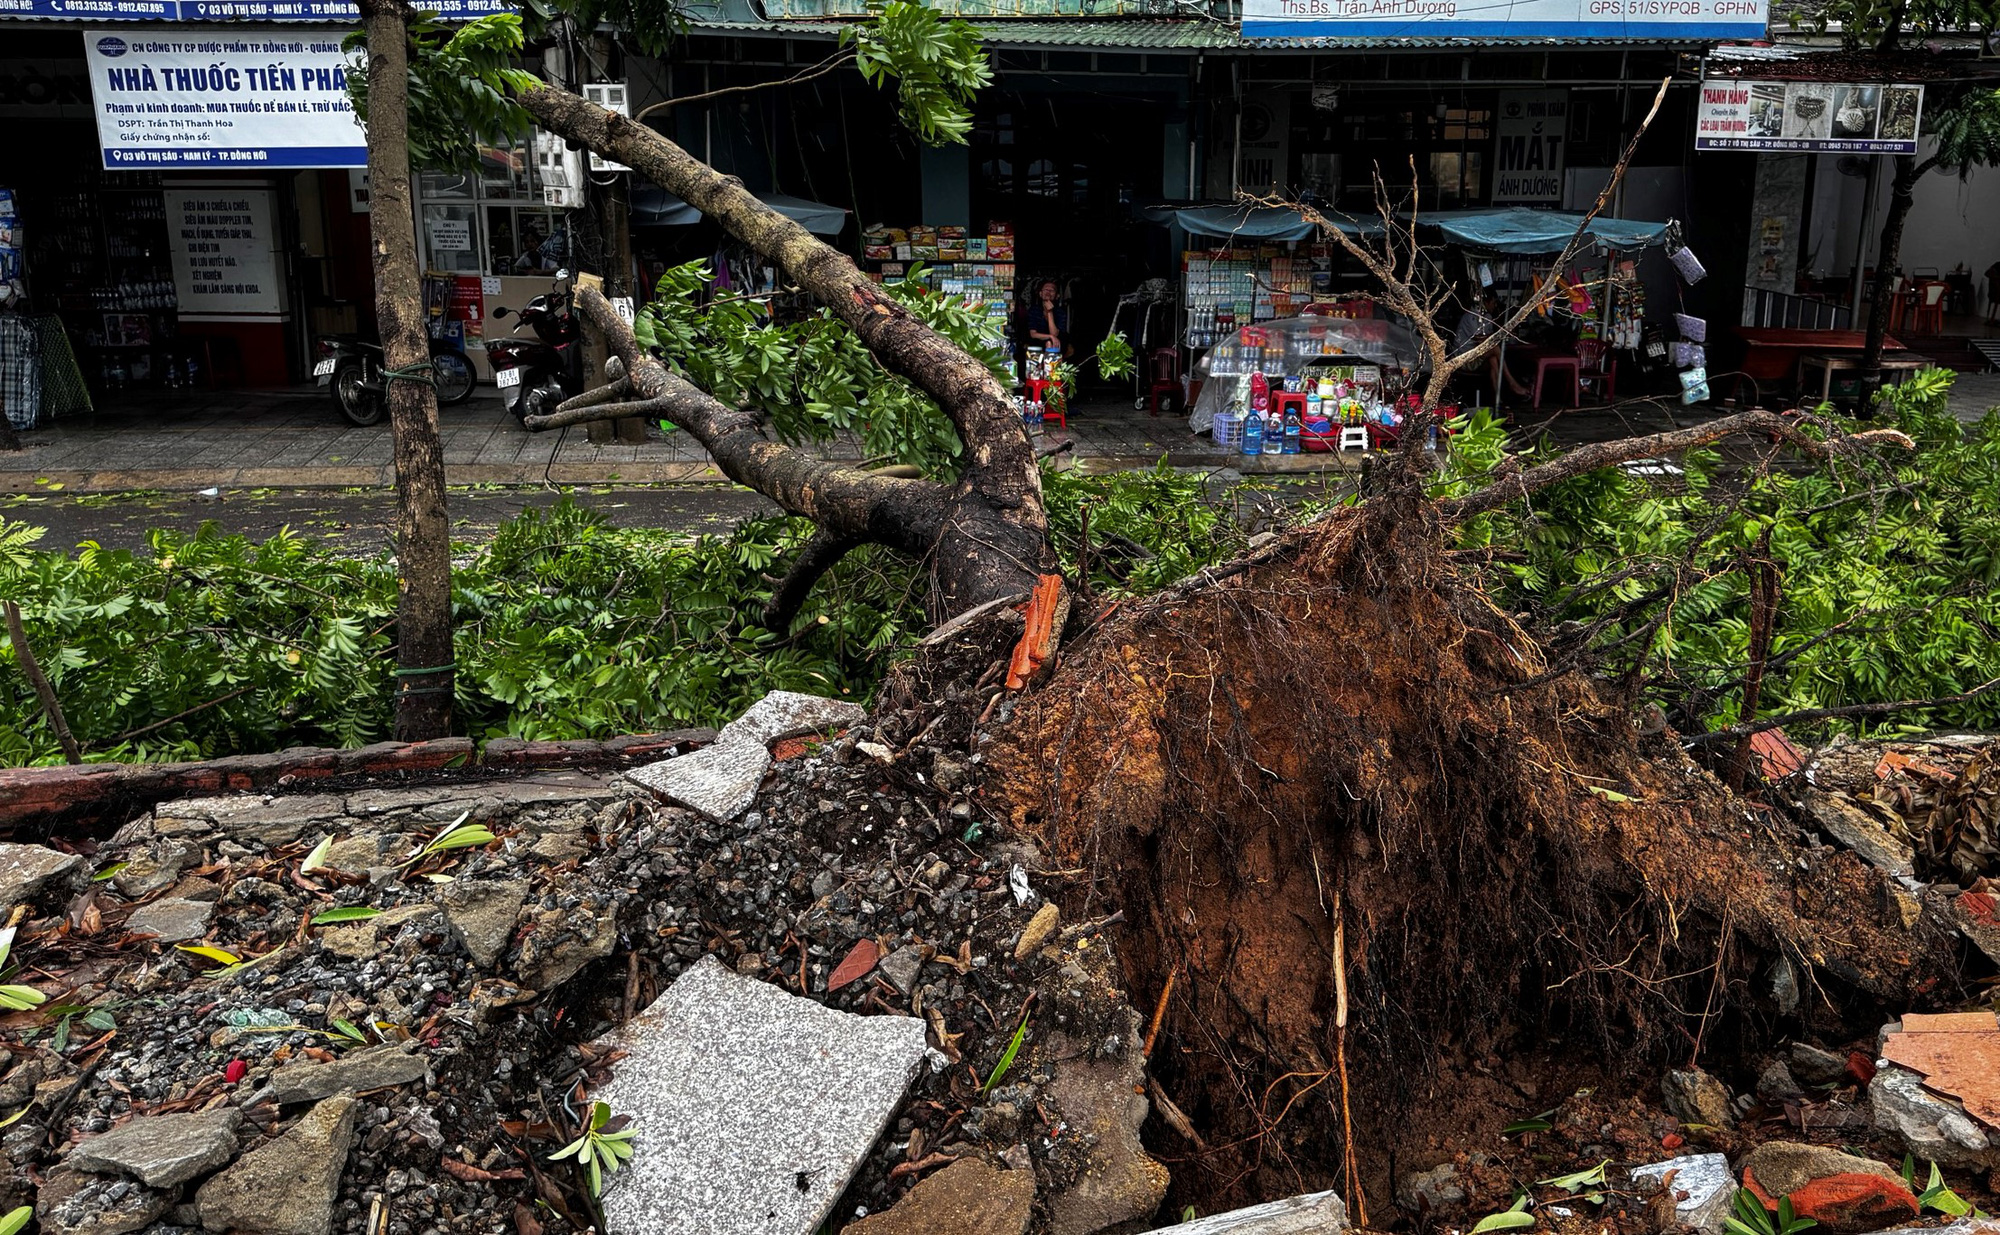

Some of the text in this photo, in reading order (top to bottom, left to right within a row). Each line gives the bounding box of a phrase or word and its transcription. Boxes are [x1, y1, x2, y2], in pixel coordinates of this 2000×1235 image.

[65, 1, 113, 11] 0813.313.535
[118, 2, 165, 13] 0912.457.895
[209, 5, 220, 15] 03
[221, 3, 234, 15] VÕ
[235, 4, 249, 17] THỊ
[250, 3, 267, 14] SÁU
[273, 4, 292, 15] NAM
[294, 3, 303, 14] LÝ
[310, 4, 323, 14] TP.
[408, 0, 461, 11] 813.313.535
[1405, 0, 1457, 17] Dương
[1589, 1, 1624, 14] GPS:
[1628, 1, 1701, 15] 51/SYPQB
[1714, 1, 1758, 15] GPHN
[132, 43, 144, 53] CN
[146, 41, 170, 53] CÔNG
[172, 43, 182, 52] TY
[184, 43, 197, 52] CP
[198, 41, 222, 56] ĐƯỢC
[250, 43, 261, 53] TP.
[263, 40, 286, 53] ĐỒNG
[288, 41, 304, 53] HỚI
[310, 40, 339, 54] QUẢNG
[107, 63, 158, 92] NHÀ
[160, 61, 241, 92] THUỐC
[245, 62, 297, 92] TIẾN
[301, 64, 348, 91] PHÁ
[1703, 88, 1727, 104] THANH
[106, 103, 135, 116] Phạm
[136, 103, 146, 113] vi
[147, 103, 170, 113] kinh
[171, 103, 206, 113] doanh:
[206, 103, 229, 113] MUA
[229, 99, 263, 113] THUỐC
[277, 100, 297, 113] BÁN
[118, 120, 145, 128] DSPT:
[185, 119, 214, 128] Thanh
[216, 120, 234, 128] Hoa
[173, 132, 195, 143] nhận
[1500, 120, 1562, 171] MẮT
[122, 152, 134, 161] 03
[134, 151, 146, 161] VÕ
[147, 152, 161, 162] THỊ
[162, 150, 178, 161] SÁU
[183, 151, 201, 161] NAM
[218, 151, 230, 160] TP.
[1498, 174, 1559, 196] ÁNH DƯƠNG
